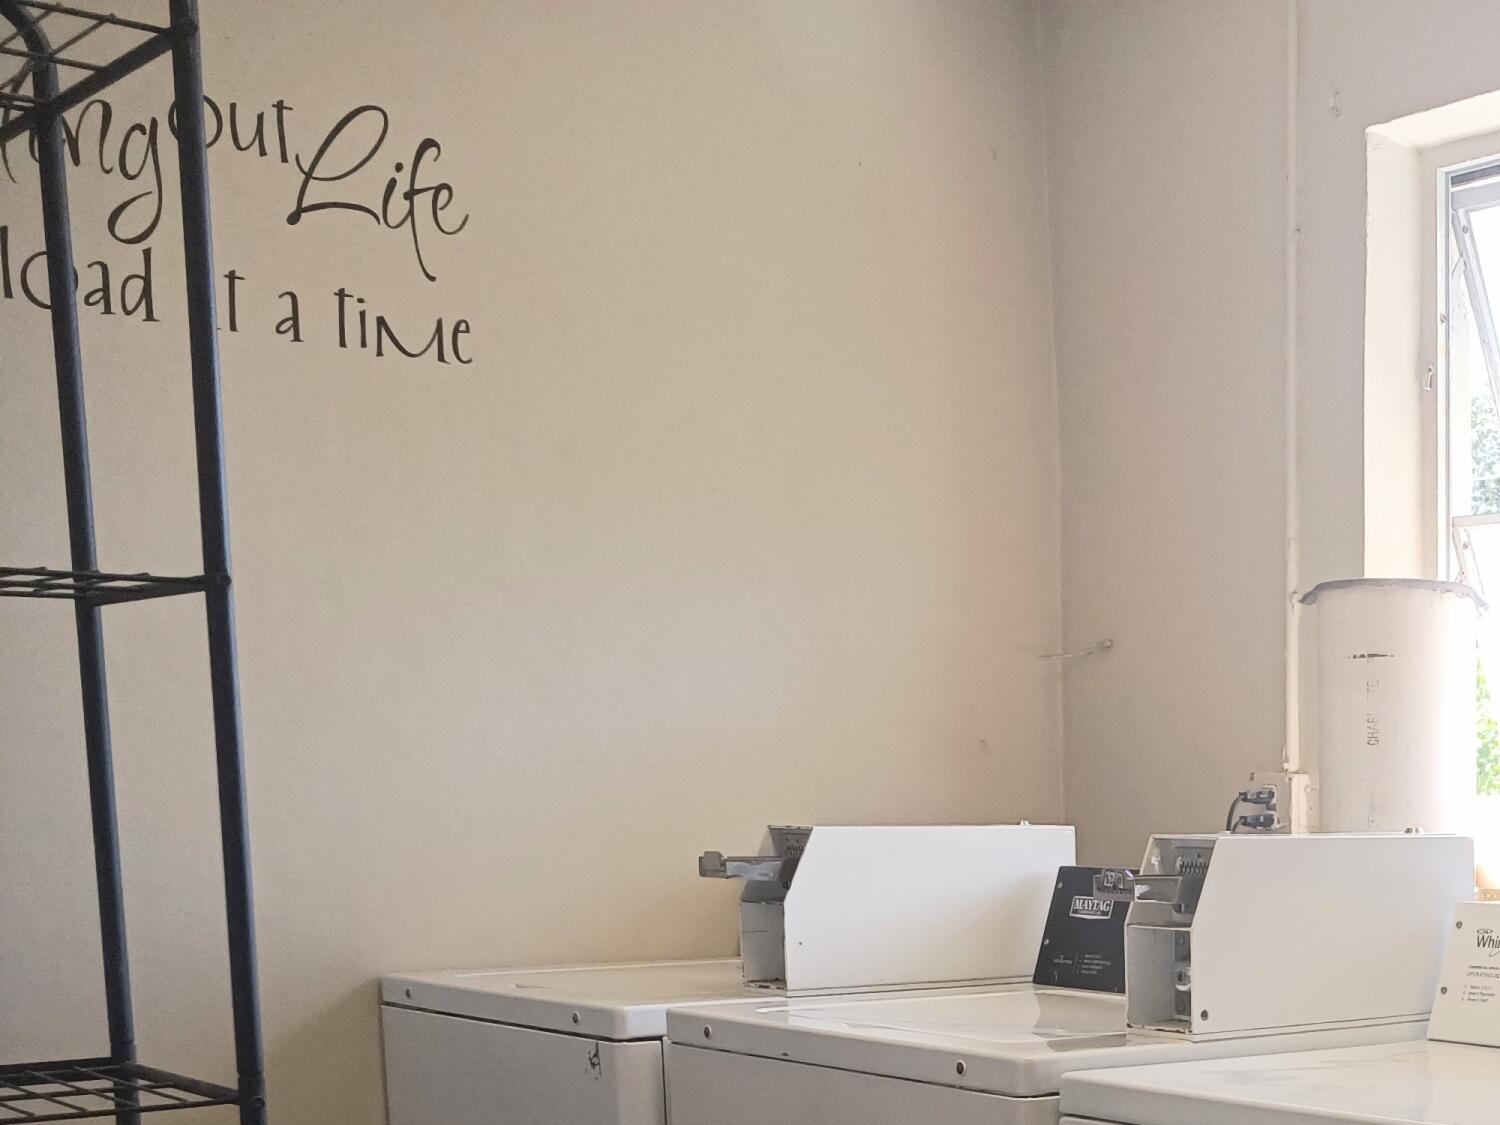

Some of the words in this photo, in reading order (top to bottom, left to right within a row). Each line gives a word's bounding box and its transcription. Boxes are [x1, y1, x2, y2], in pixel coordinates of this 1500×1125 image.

[286, 104, 469, 282] Life
[0, 225, 160, 322] load
[275, 291, 304, 343] a
[1073, 899, 1111, 912] MAYTAG
